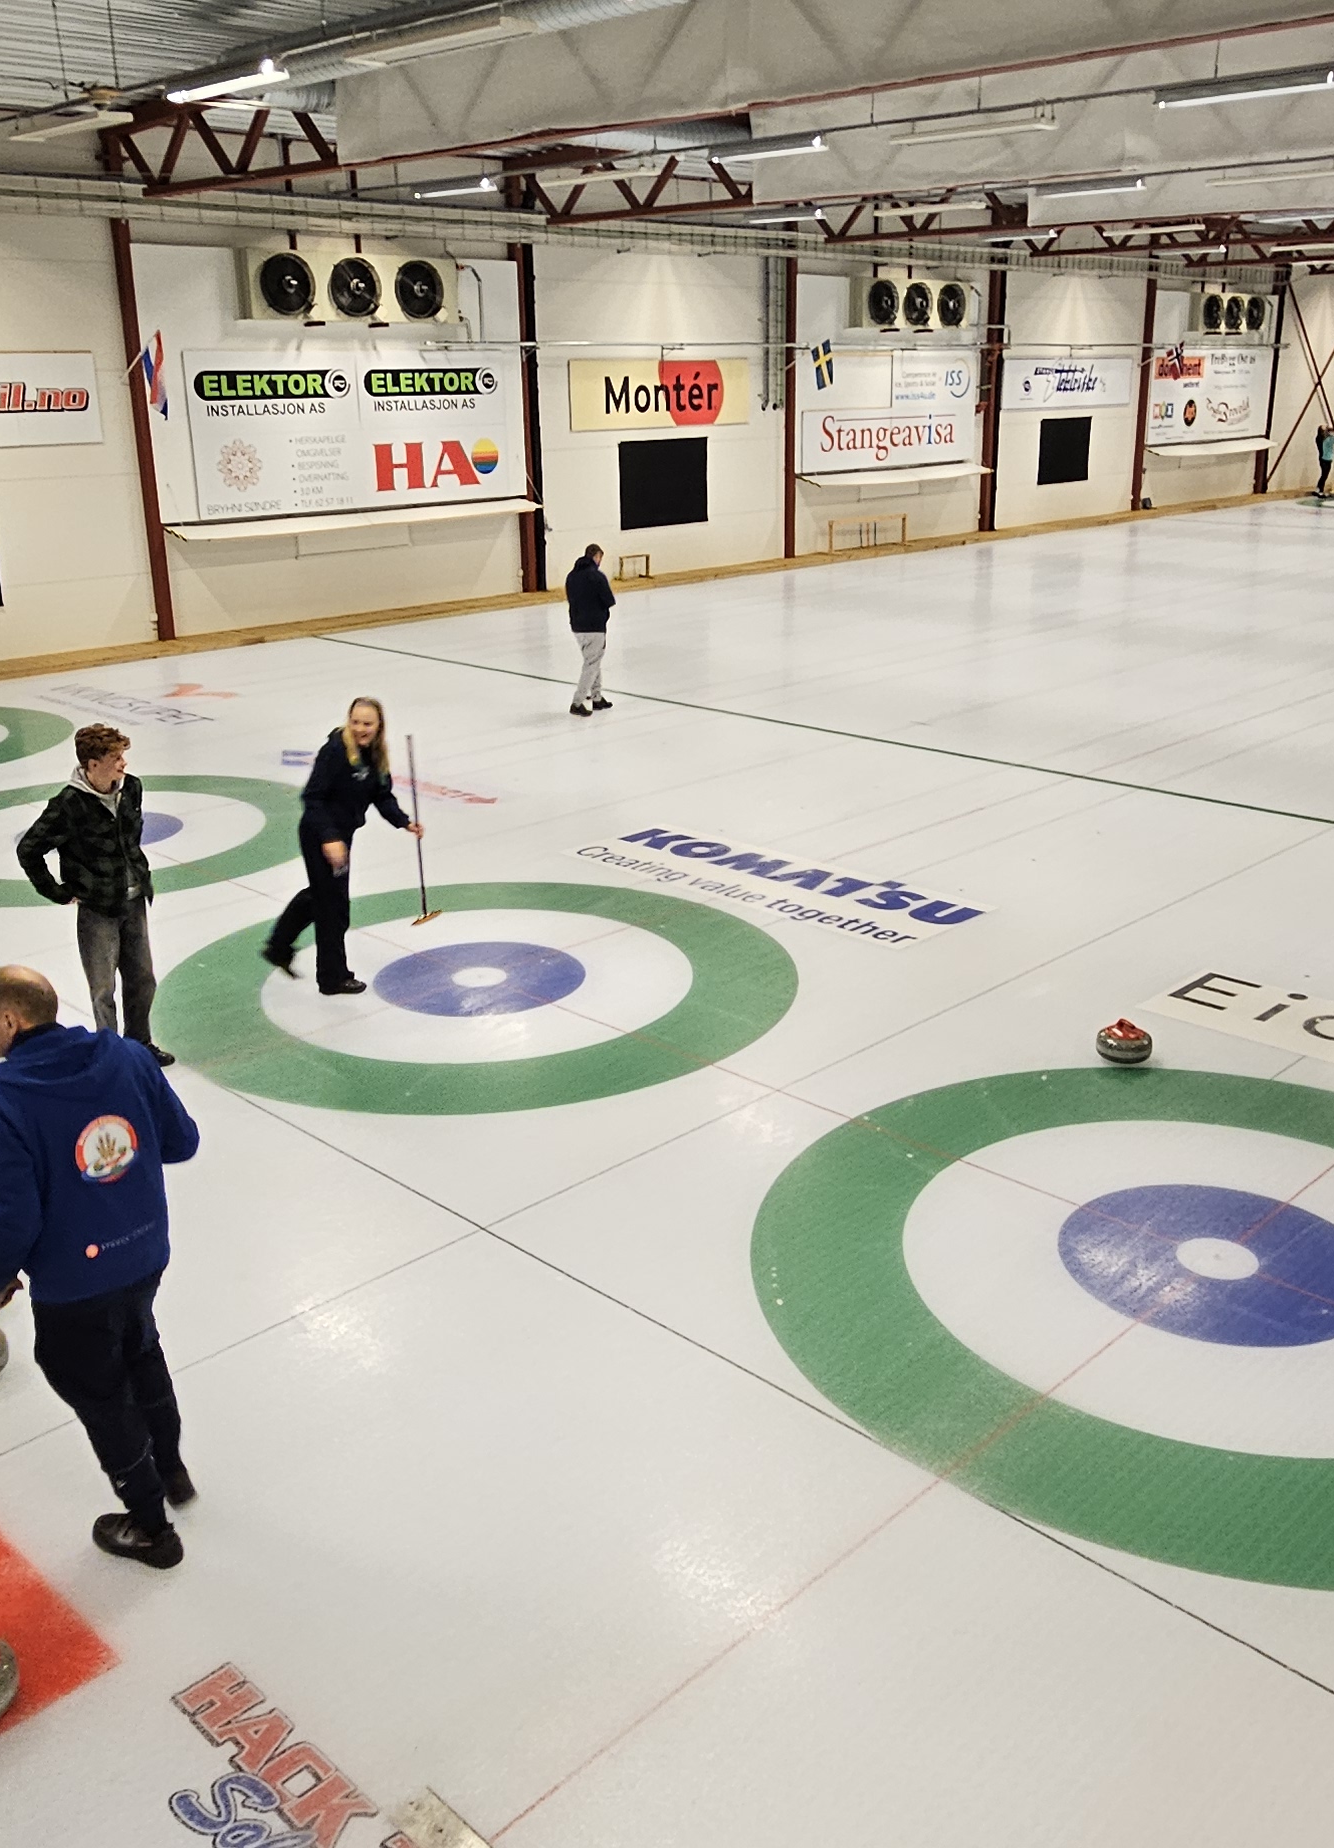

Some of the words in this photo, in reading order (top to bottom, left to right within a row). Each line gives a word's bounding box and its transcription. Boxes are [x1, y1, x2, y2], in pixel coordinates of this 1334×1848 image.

[202, 373, 325, 397] ELEKTOR
[371, 372, 475, 393] ELEKTOR
[604, 371, 719, 414] Montér
[945, 370, 963, 386] ISS
[206, 403, 305, 417] INSTALLASJON
[309, 402, 326, 414] AS
[374, 399, 458, 411] INSTALLASJON
[461, 398, 476, 410] AS
[820, 414, 955, 461] Stangeavisa
[372, 440, 481, 492] HA
[207, 502, 243, 516] BRYHNI
[618, 827, 985, 925] KOMATSU
[575, 844, 689, 883] Creating
[689, 876, 766, 905] value
[766, 895, 918, 946] together
[170, 1661, 379, 1848] HACK
